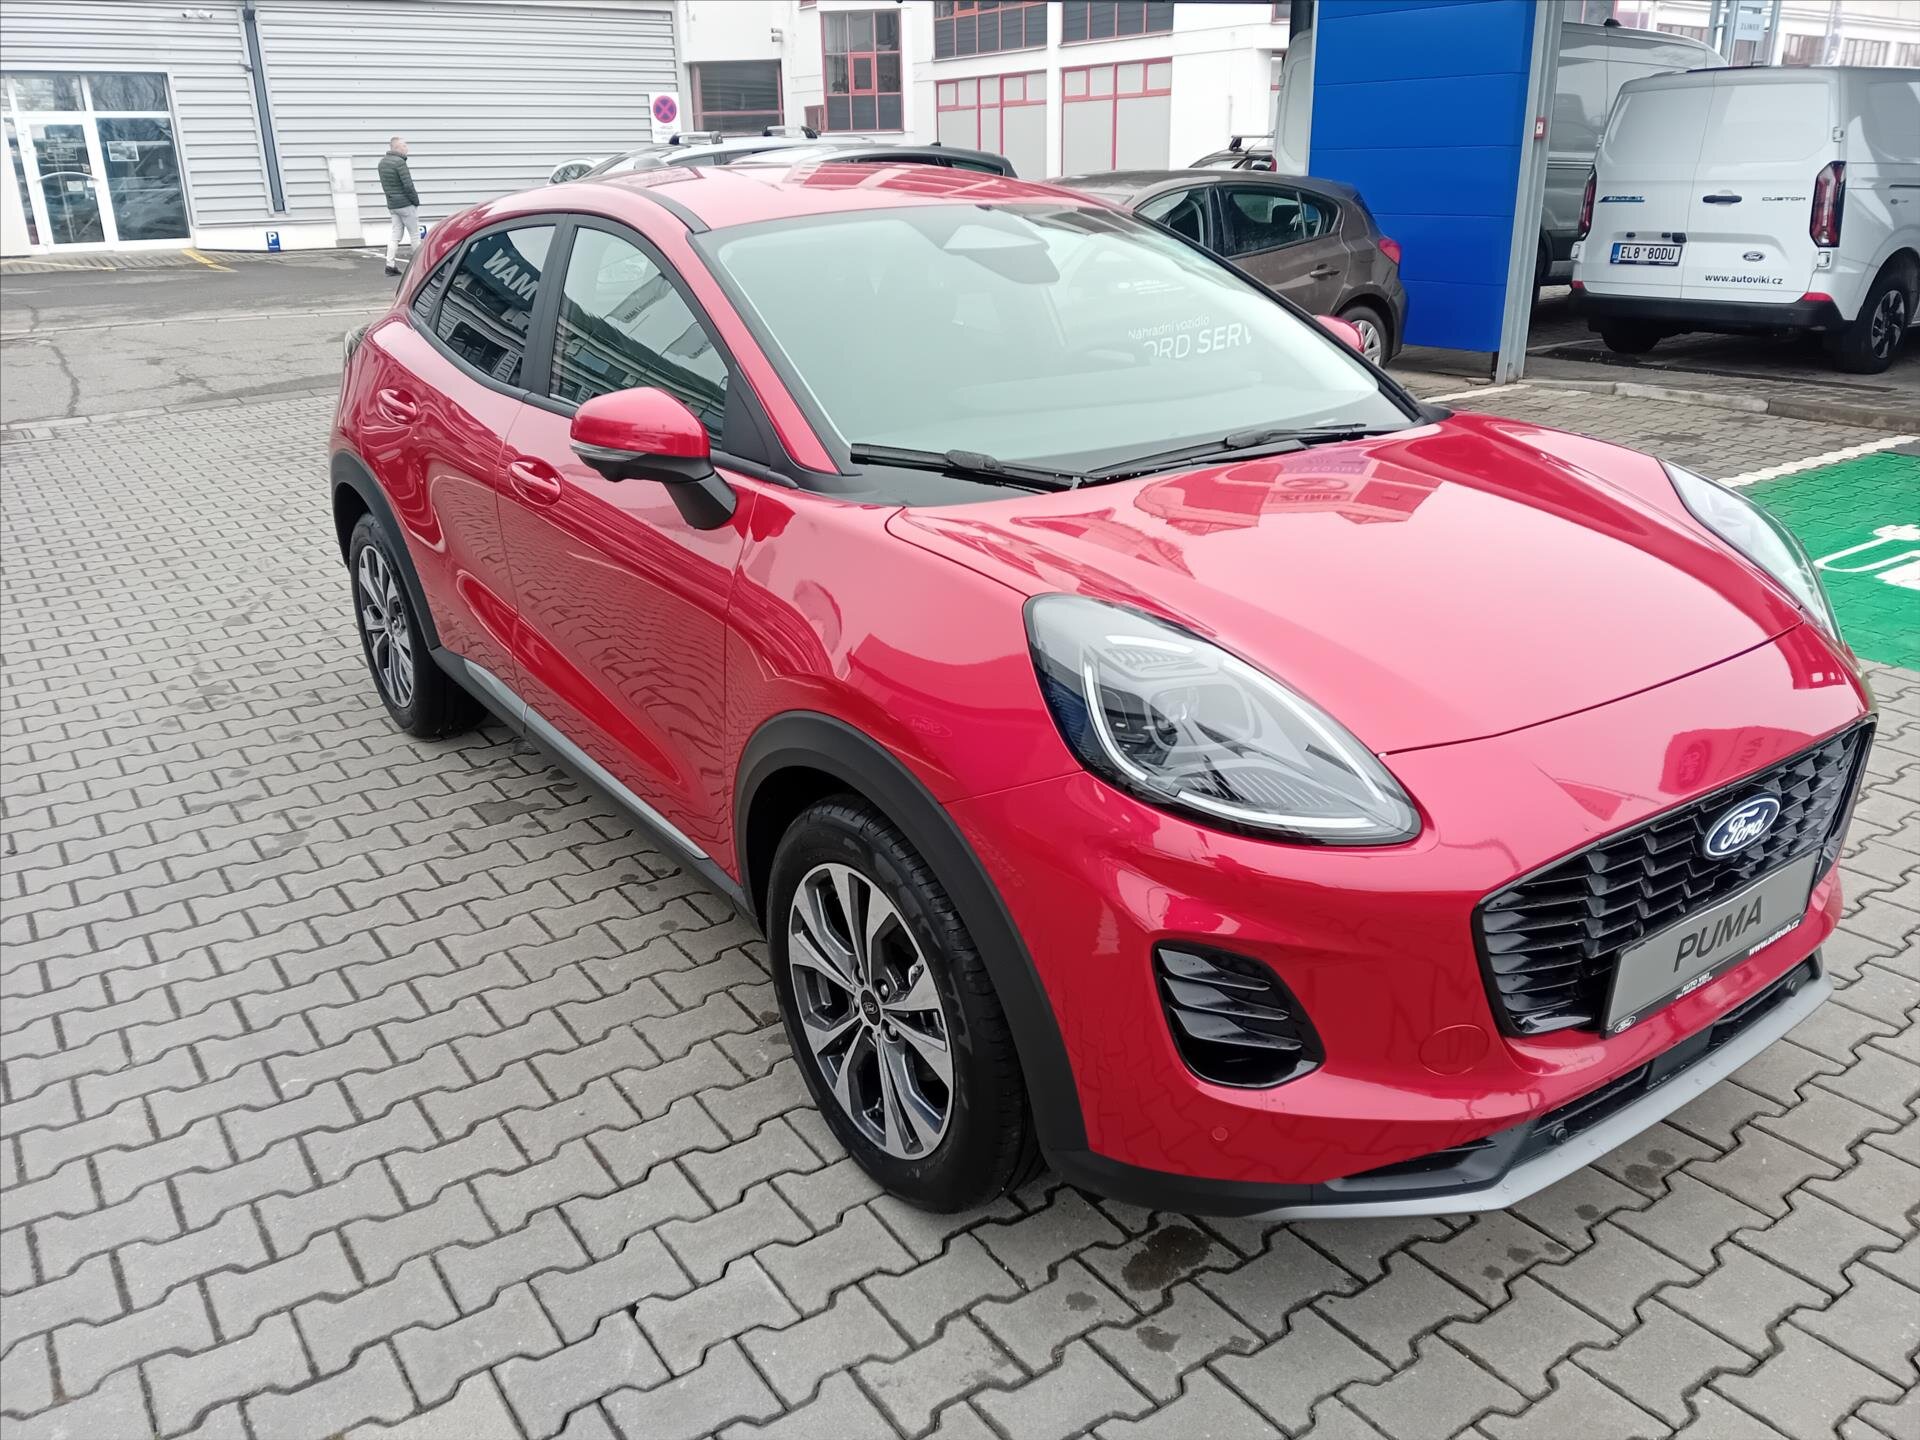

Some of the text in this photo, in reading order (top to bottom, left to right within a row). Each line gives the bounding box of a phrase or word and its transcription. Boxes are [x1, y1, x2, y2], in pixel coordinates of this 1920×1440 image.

[268, 233, 277, 244] P
[1620, 246, 1641, 259] EL8
[1647, 247, 1676, 260] 80DU
[1705, 274, 1783, 285] www.autoviki.cz
[1720, 807, 1769, 851] Ford
[1673, 896, 1762, 973] PUMA
